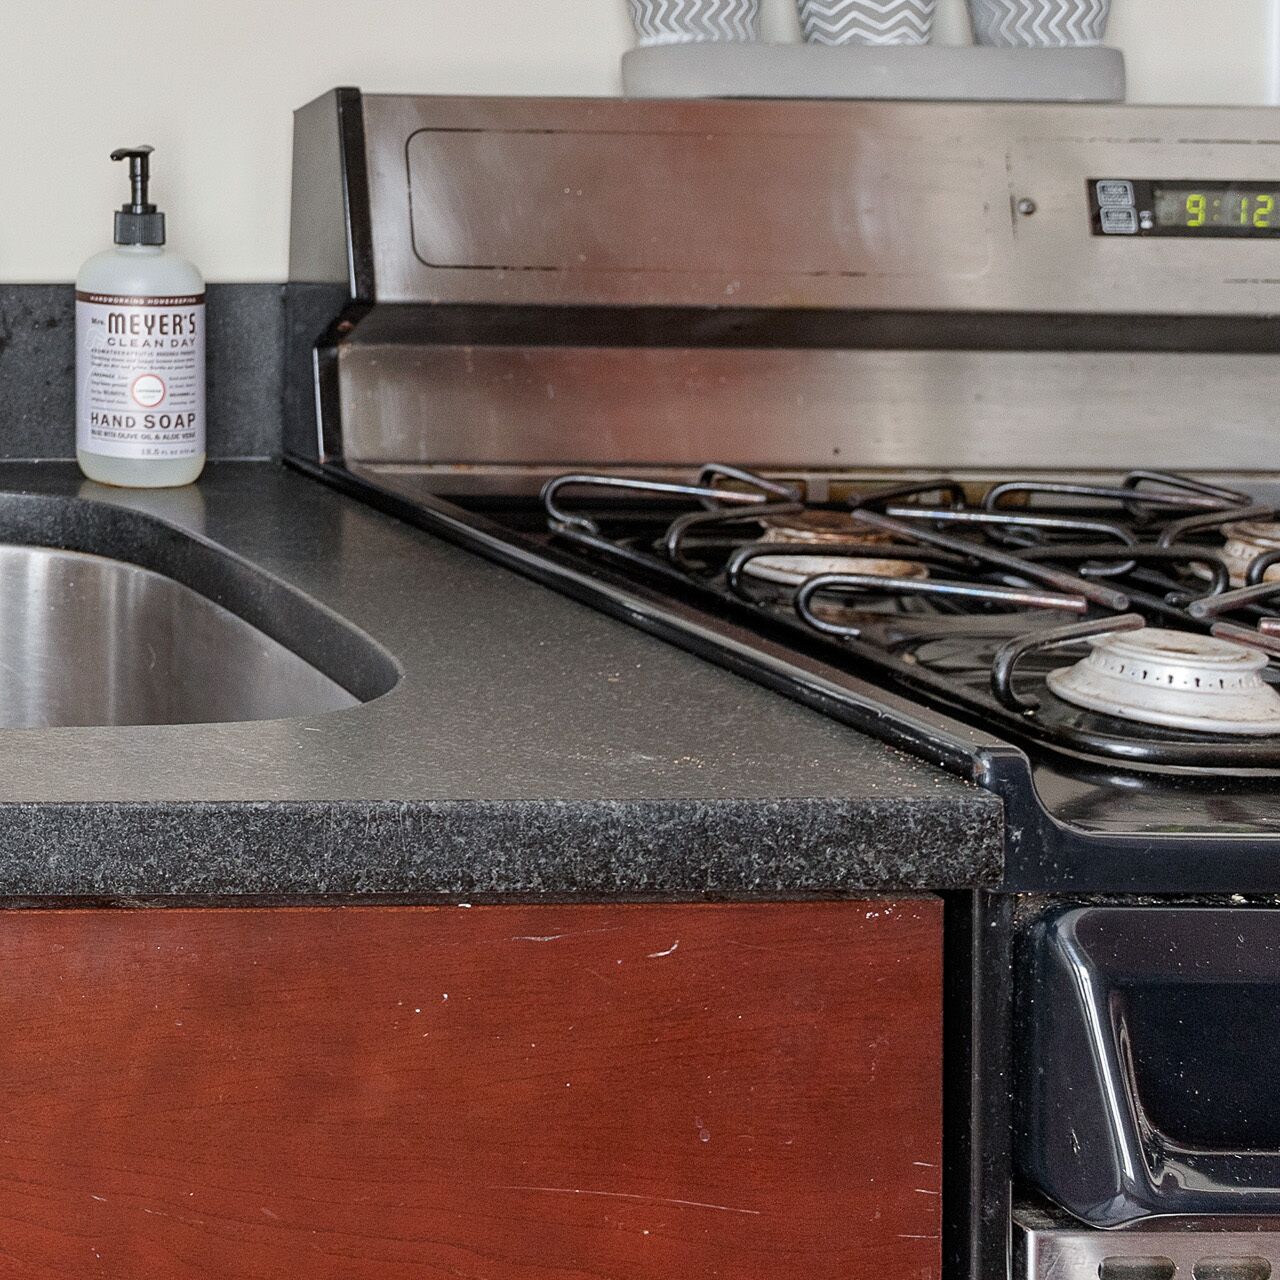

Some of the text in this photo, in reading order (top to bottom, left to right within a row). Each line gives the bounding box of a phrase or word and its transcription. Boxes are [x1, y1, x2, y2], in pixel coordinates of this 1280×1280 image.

[1186, 194, 1274, 228] 9:12
[108, 312, 196, 335] MEYER'S
[107, 338, 196, 348] CLEAN DAY
[91, 412, 196, 429] HAND SOAP
